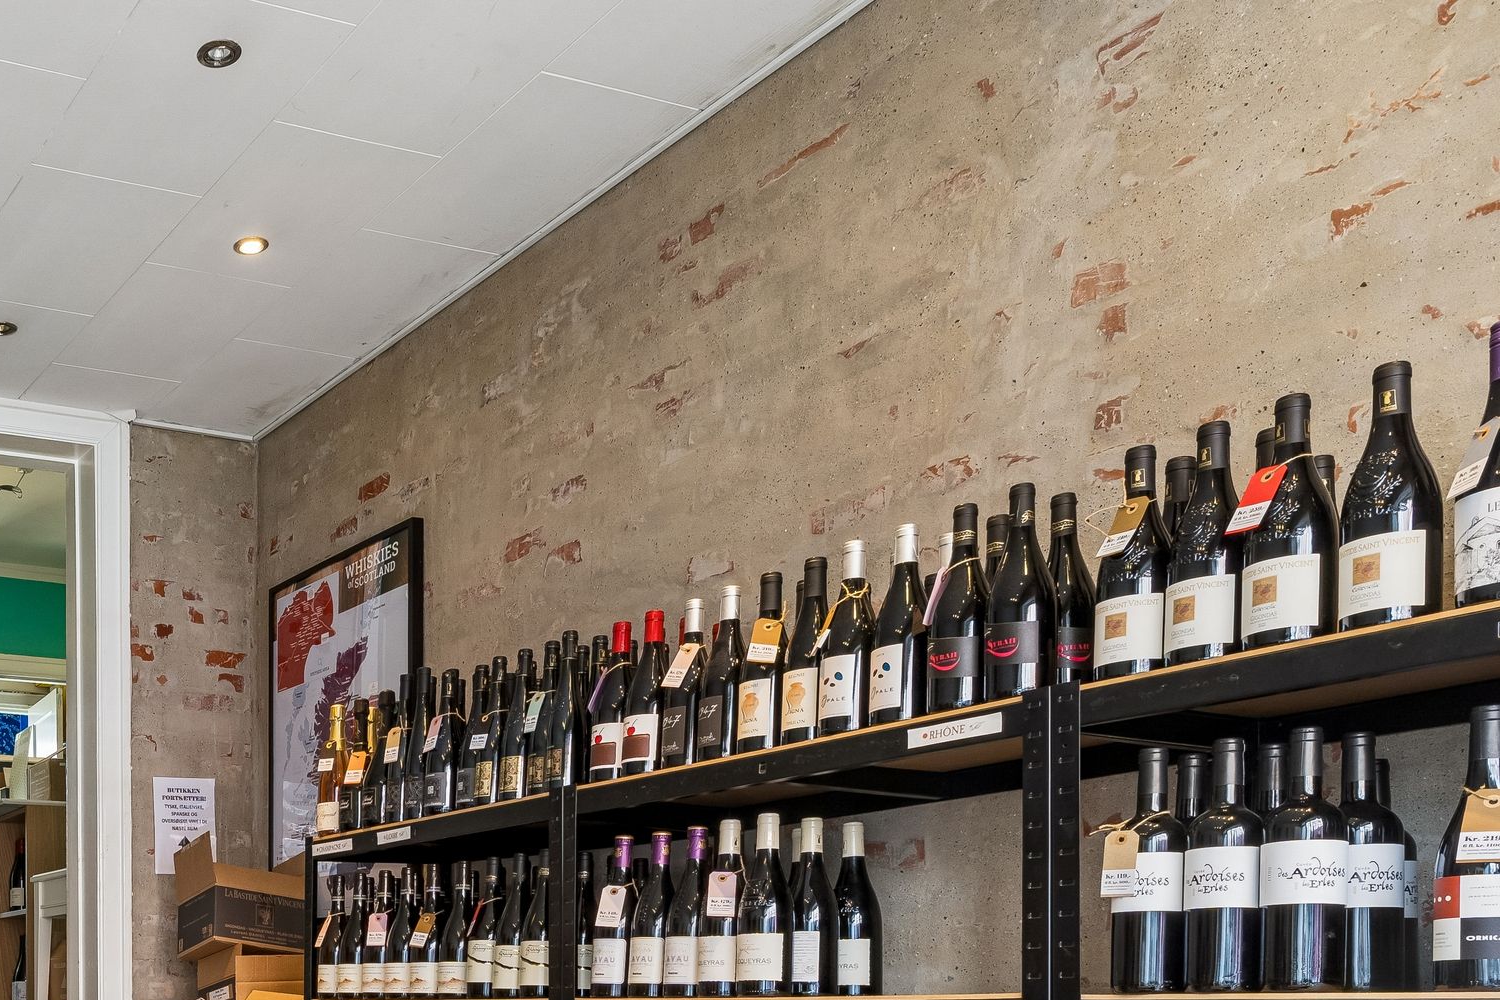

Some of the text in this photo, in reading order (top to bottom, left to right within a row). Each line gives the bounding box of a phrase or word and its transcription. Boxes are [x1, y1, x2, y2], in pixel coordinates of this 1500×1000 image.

[1358, 536, 1420, 552] SAINT VINCENT
[345, 541, 399, 579] WHISKIES
[1279, 560, 1314, 570] VINCENT
[347, 560, 396, 589] of SCOTLAND
[1197, 580, 1230, 590] VINCENT
[1129, 598, 1160, 606] VINCENT
[929, 724, 966, 740] RHÔNE
[1189, 864, 1245, 886] Ardoises
[1287, 856, 1346, 879] Ardoises
[1348, 860, 1404, 884] Ardoises
